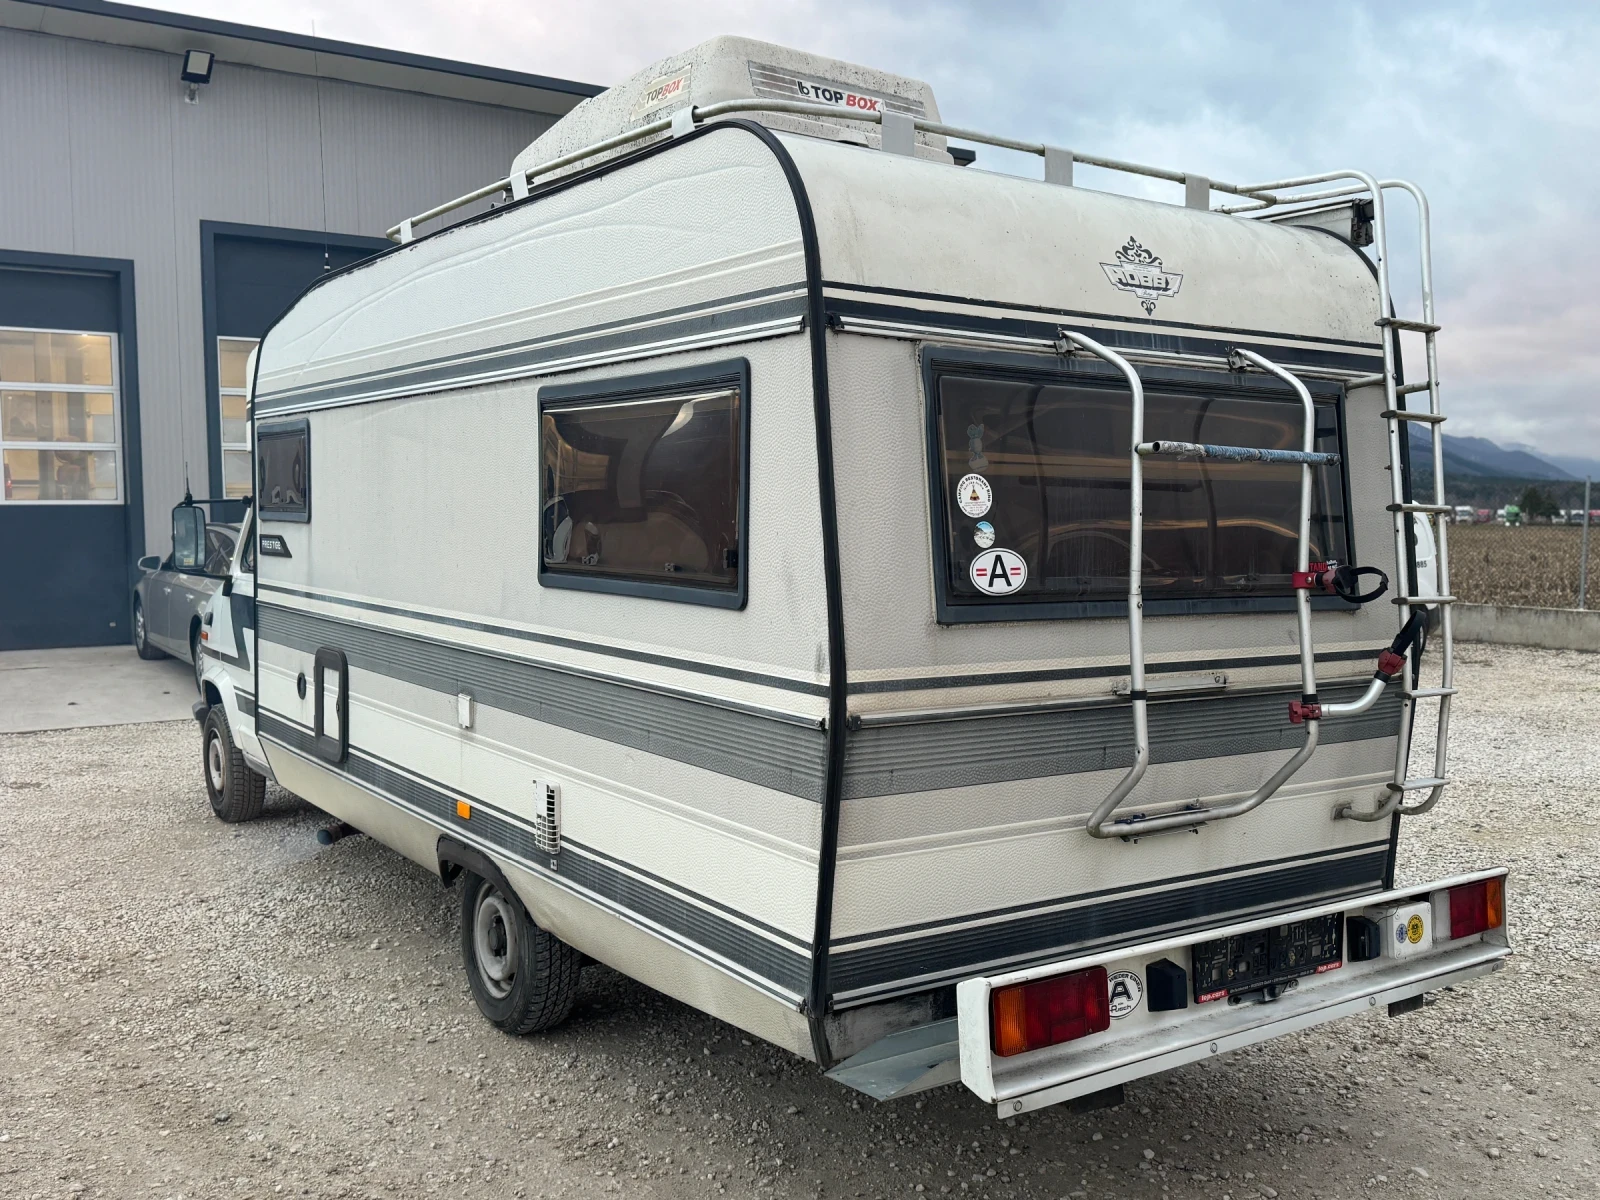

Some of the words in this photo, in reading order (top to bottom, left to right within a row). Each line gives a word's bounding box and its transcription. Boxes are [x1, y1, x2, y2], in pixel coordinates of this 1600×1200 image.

[810, 85, 844, 103] TOP
[846, 94, 879, 111] BOX
[1107, 267, 1181, 292] HOBBY
[988, 554, 1012, 588] A
[1108, 978, 1134, 1005] A
